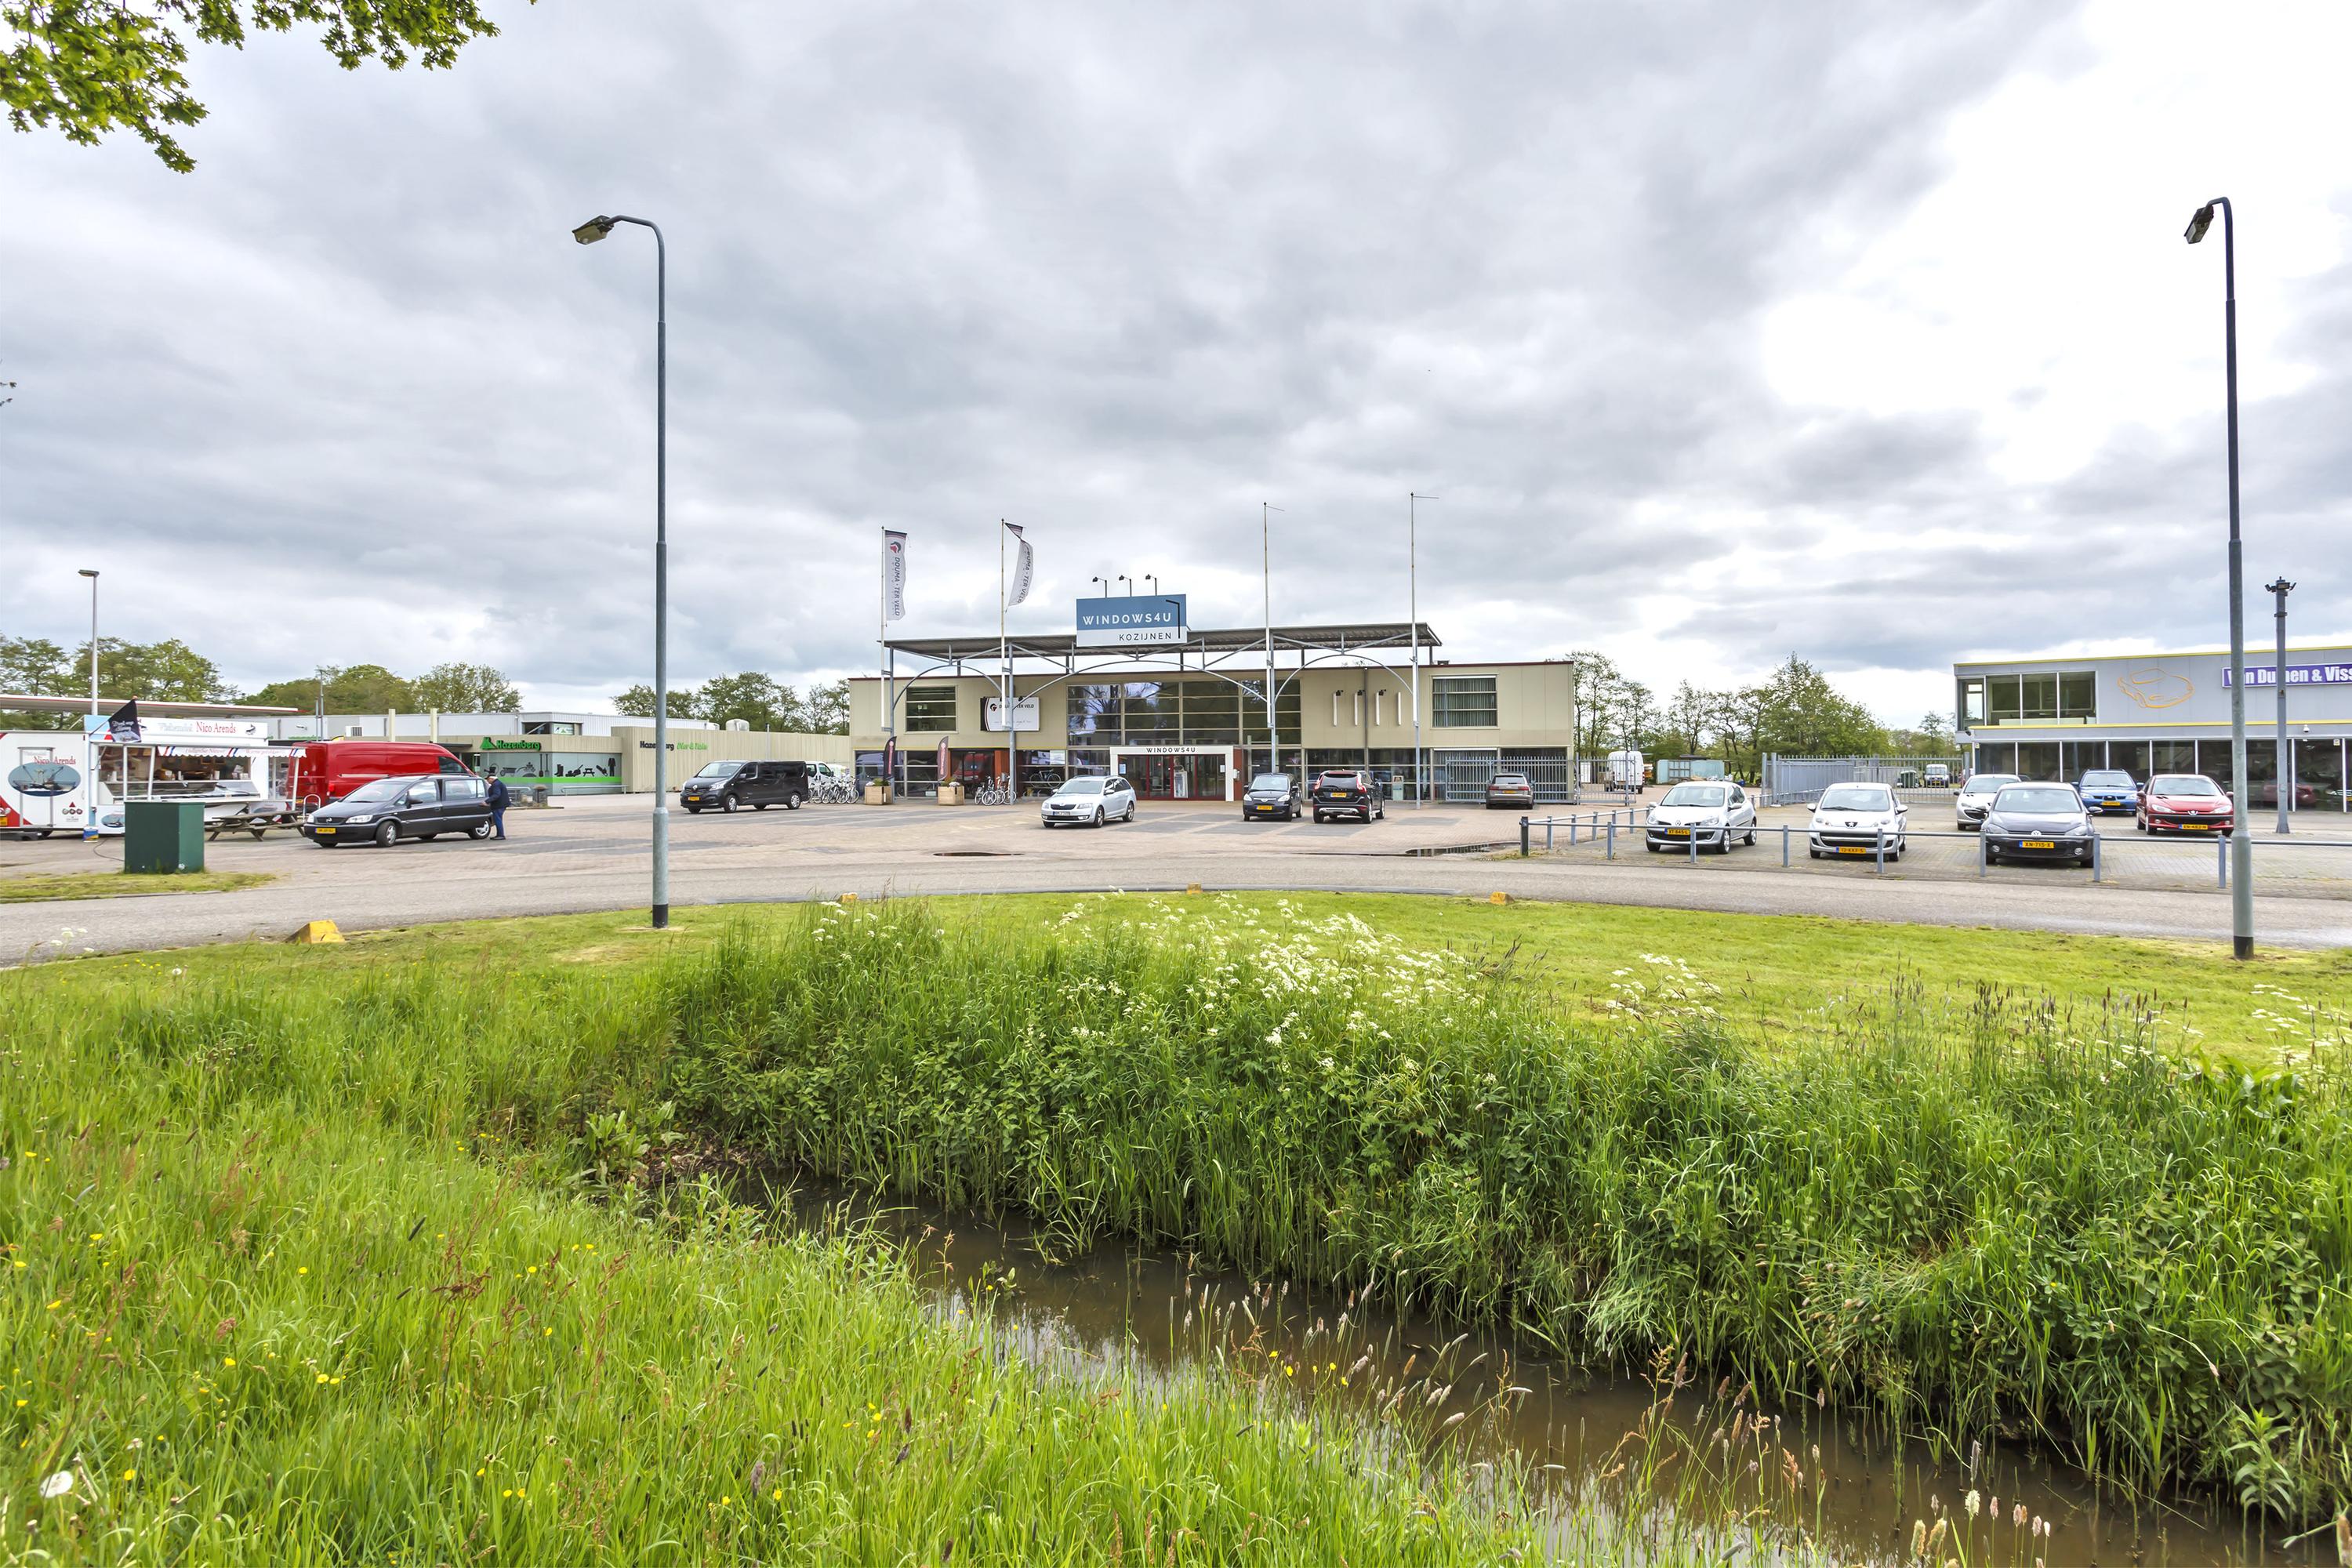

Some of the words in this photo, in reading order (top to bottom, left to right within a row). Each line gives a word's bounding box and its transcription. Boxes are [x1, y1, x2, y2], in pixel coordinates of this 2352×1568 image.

[1083, 612, 1171, 625] WINDOWS4U
[1119, 632, 1171, 641] KOZIJNEN
[2311, 669, 2322, 682] &
[196, 721, 212, 732] Nico
[213, 723, 237, 734] Arends
[495, 740, 542, 751] Hazenberg
[640, 741, 674, 751] Hazeerg
[34, 755, 50, 765] Nico
[54, 755, 76, 765] Arends
